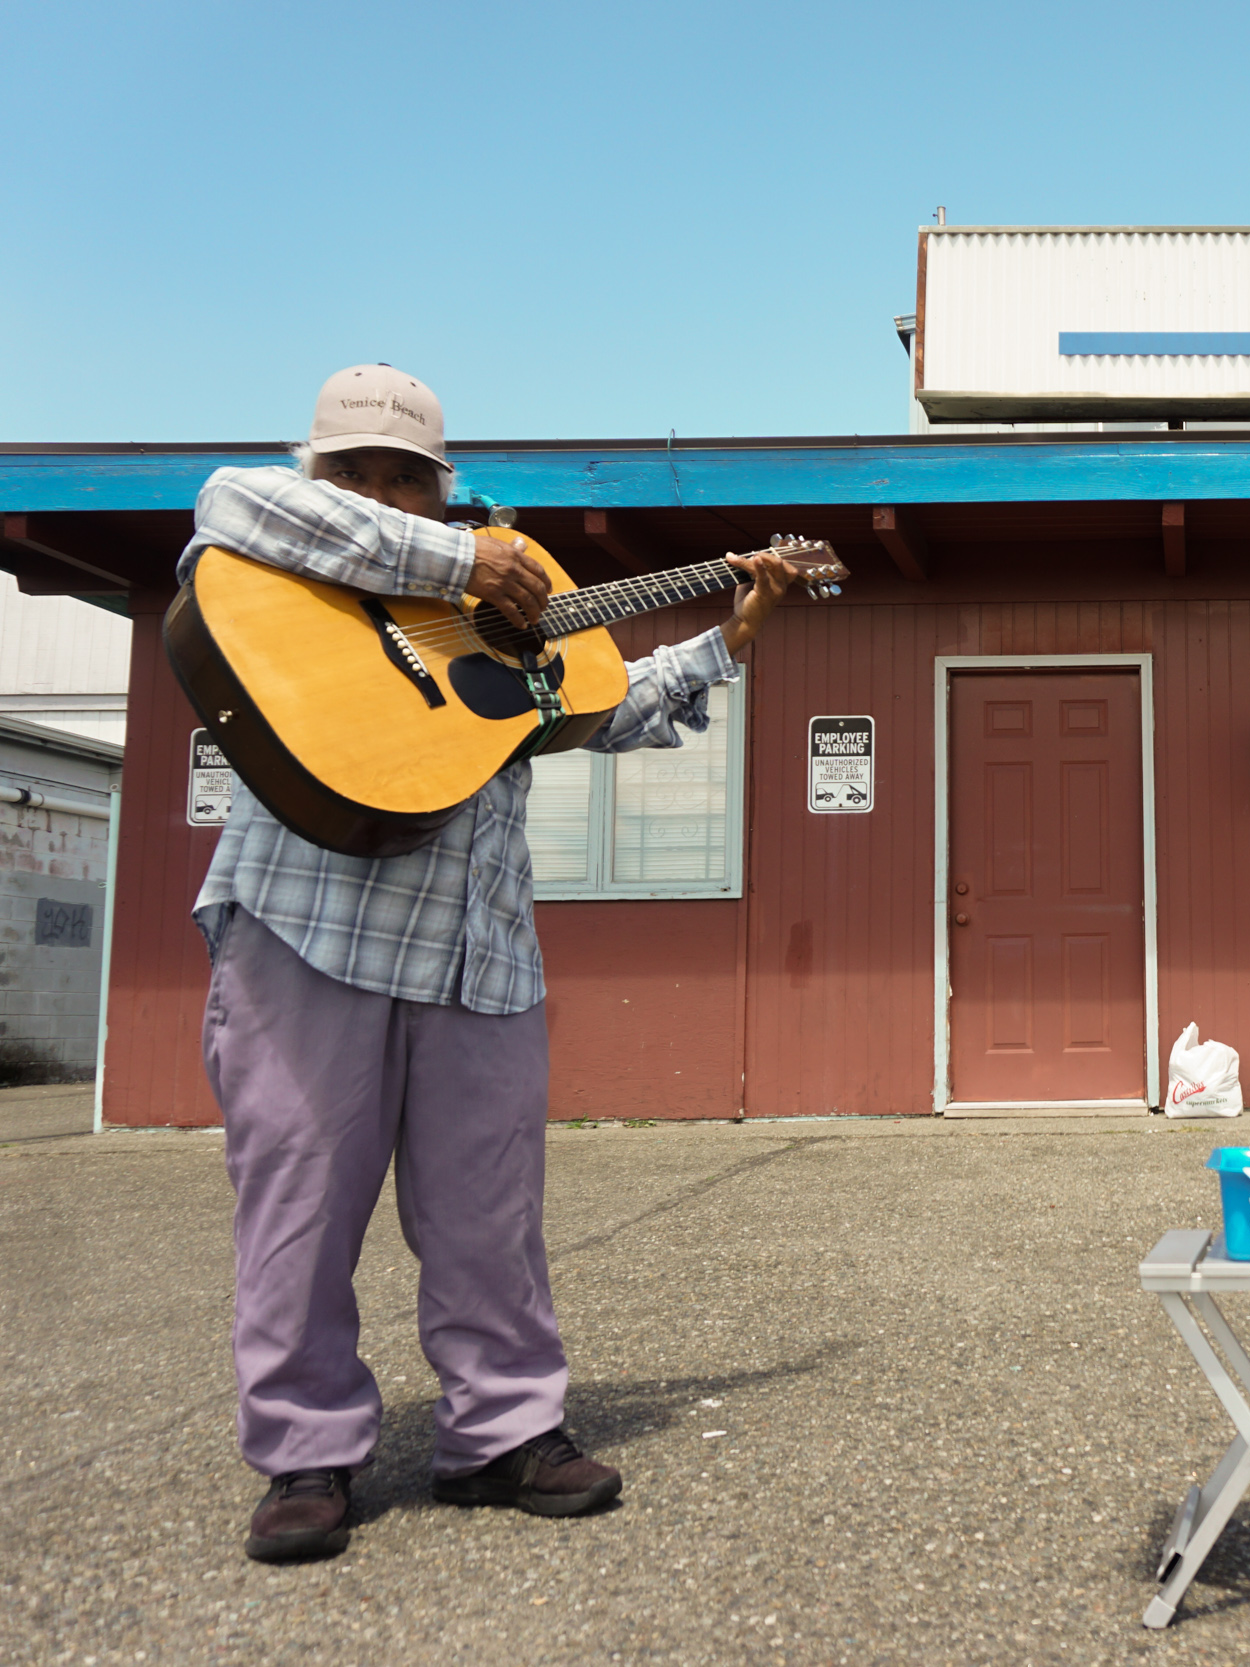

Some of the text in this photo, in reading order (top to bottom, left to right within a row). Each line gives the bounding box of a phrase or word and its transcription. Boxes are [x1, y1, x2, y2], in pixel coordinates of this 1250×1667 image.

[340, 397, 427, 426] Venice Beach
[815, 732, 869, 744] EMPLOYEE
[819, 743, 865, 754] PARKING
